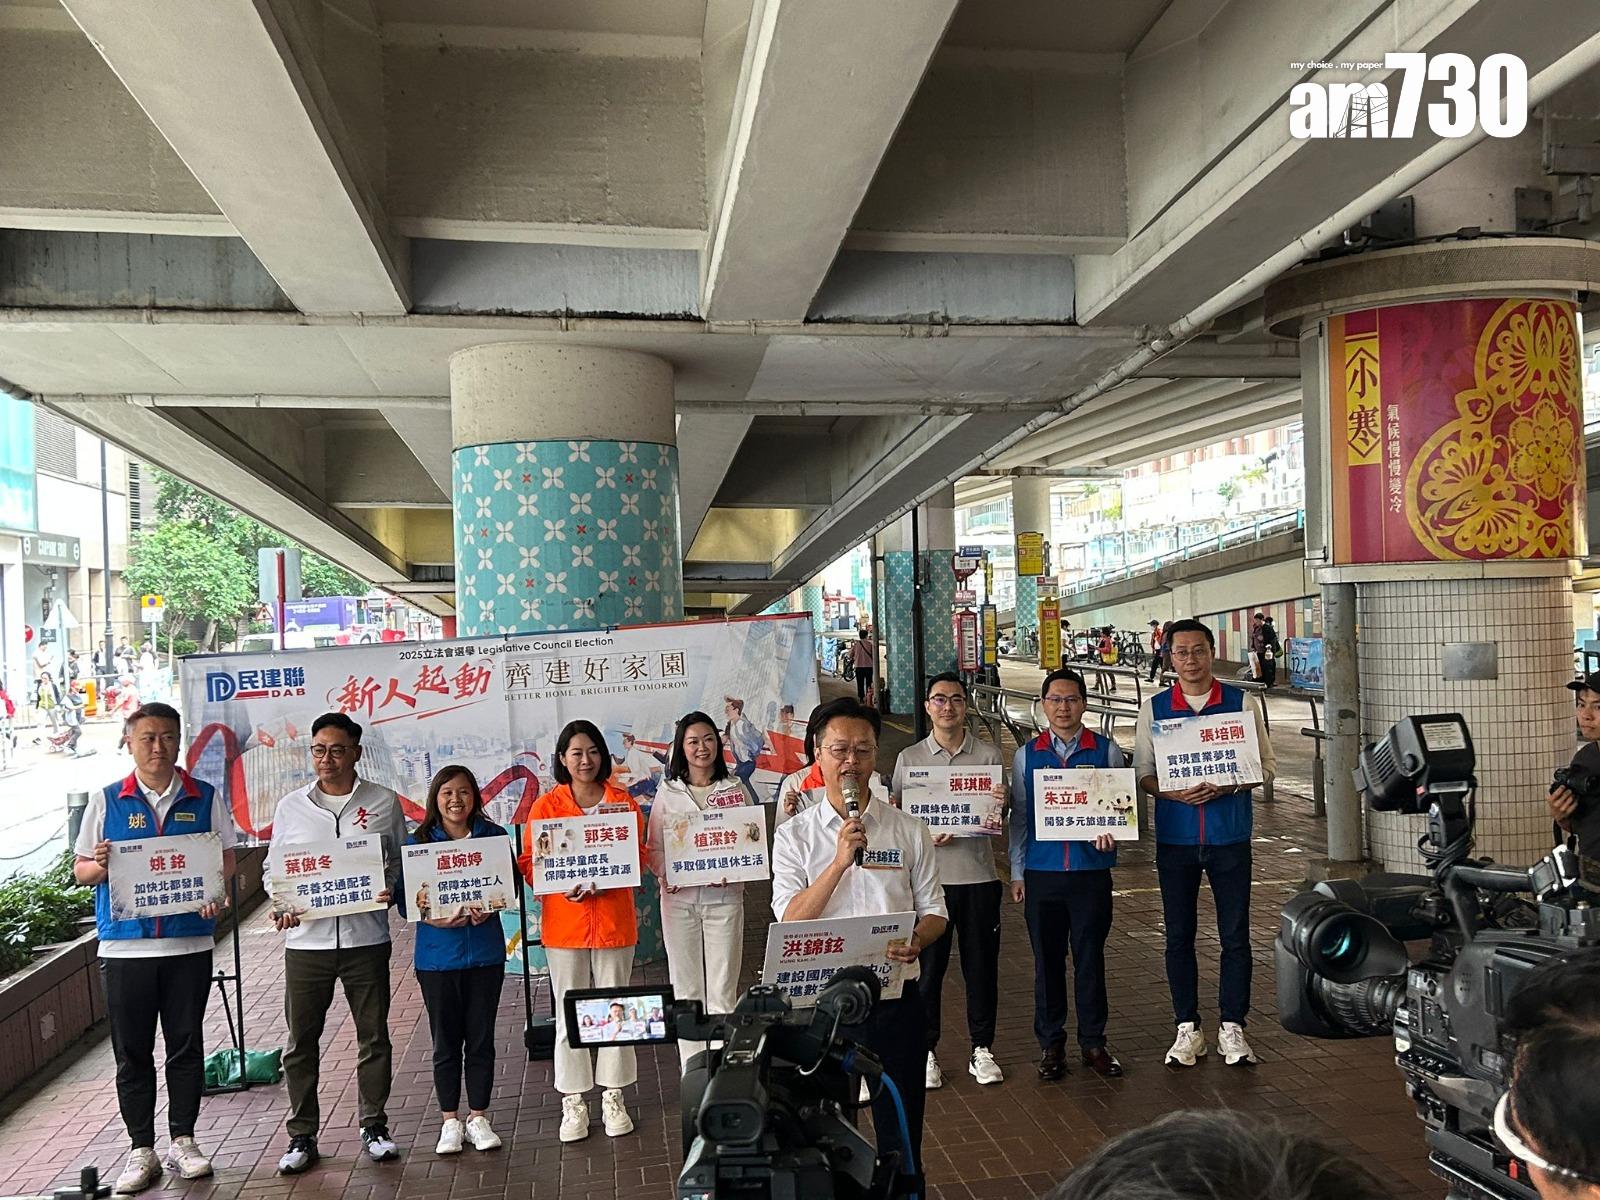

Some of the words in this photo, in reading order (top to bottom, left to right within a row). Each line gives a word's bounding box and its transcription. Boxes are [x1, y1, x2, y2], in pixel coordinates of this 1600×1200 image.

[1347, 357, 1381, 446] 小寒
[1386, 404, 1402, 513] 氣候慢慢變冷
[400, 645, 475, 660] 2025立法會選舉
[478, 643, 531, 656] Legislative
[533, 639, 572, 651] Council
[574, 637, 614, 648] Election
[238, 666, 305, 690] 民建聯
[505, 651, 686, 690] 齊建好家園
[271, 688, 306, 698] DAB
[336, 662, 492, 719] 新人起動
[504, 692, 541, 701] BETTER
[545, 689, 577, 699] HOME,
[580, 686, 629, 696] BRIGHTER
[633, 681, 689, 694] TOMORROW
[1200, 725, 1245, 742] 張培剛
[1167, 749, 1236, 766] 實現置業夢想
[1169, 762, 1239, 779] 改善居住環境
[1044, 790, 1088, 805] 朱立威
[352, 806, 379, 830] 冬
[910, 803, 971, 814] 發展綠色航運
[128, 812, 147, 829] 姚
[1044, 816, 1127, 826] 開發多元旅遊產品
[584, 825, 629, 844] 郭芙蓉
[693, 830, 738, 848] 植潔鈴
[149, 853, 186, 871] 姚銘
[284, 854, 333, 875] 葉傲冬
[437, 851, 483, 870] 盧婉婷
[544, 853, 609, 869] 關注學童成長
[672, 853, 763, 873] 爭取優質退休生活
[544, 863, 632, 881] 保障本地學生資源
[134, 876, 204, 895] 加快北都發展
[297, 875, 371, 897] 完善交通配套
[437, 875, 503, 892] 保障本地工人
[135, 890, 205, 908] 拉動香港經濟
[310, 889, 373, 908] 增加泊車位
[438, 890, 483, 905] 優先就業
[782, 936, 845, 958] 洪錦鉉
